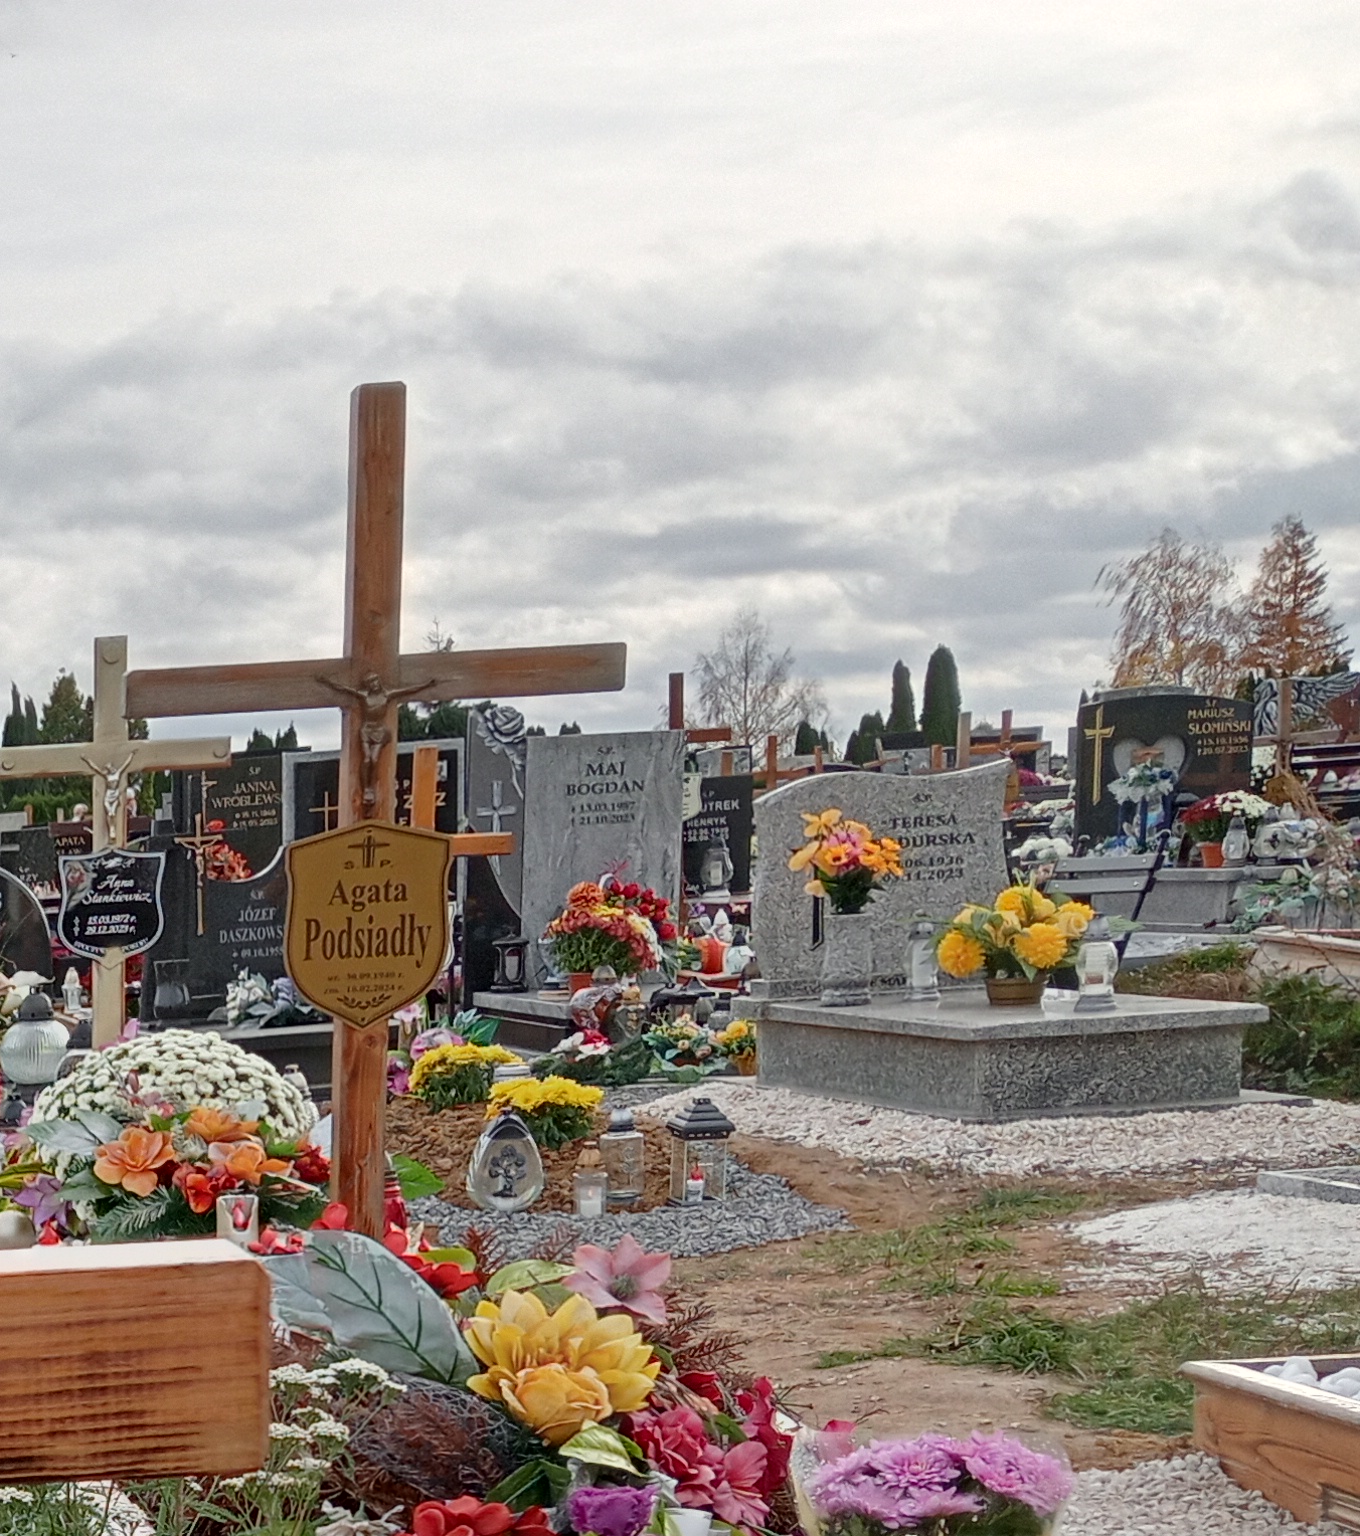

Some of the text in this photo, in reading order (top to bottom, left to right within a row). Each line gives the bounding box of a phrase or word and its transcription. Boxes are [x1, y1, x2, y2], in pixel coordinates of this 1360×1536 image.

[585, 761, 626, 777] MAJ
[233, 780, 277, 794] JANINA
[565, 780, 645, 797] BOGDAN
[889, 813, 958, 830] TERESA
[82, 888, 153, 906] Stankiewicz
[327, 879, 408, 912] Agata
[238, 905, 277, 922] JÓZEF
[303, 913, 432, 969] Podsiadły
